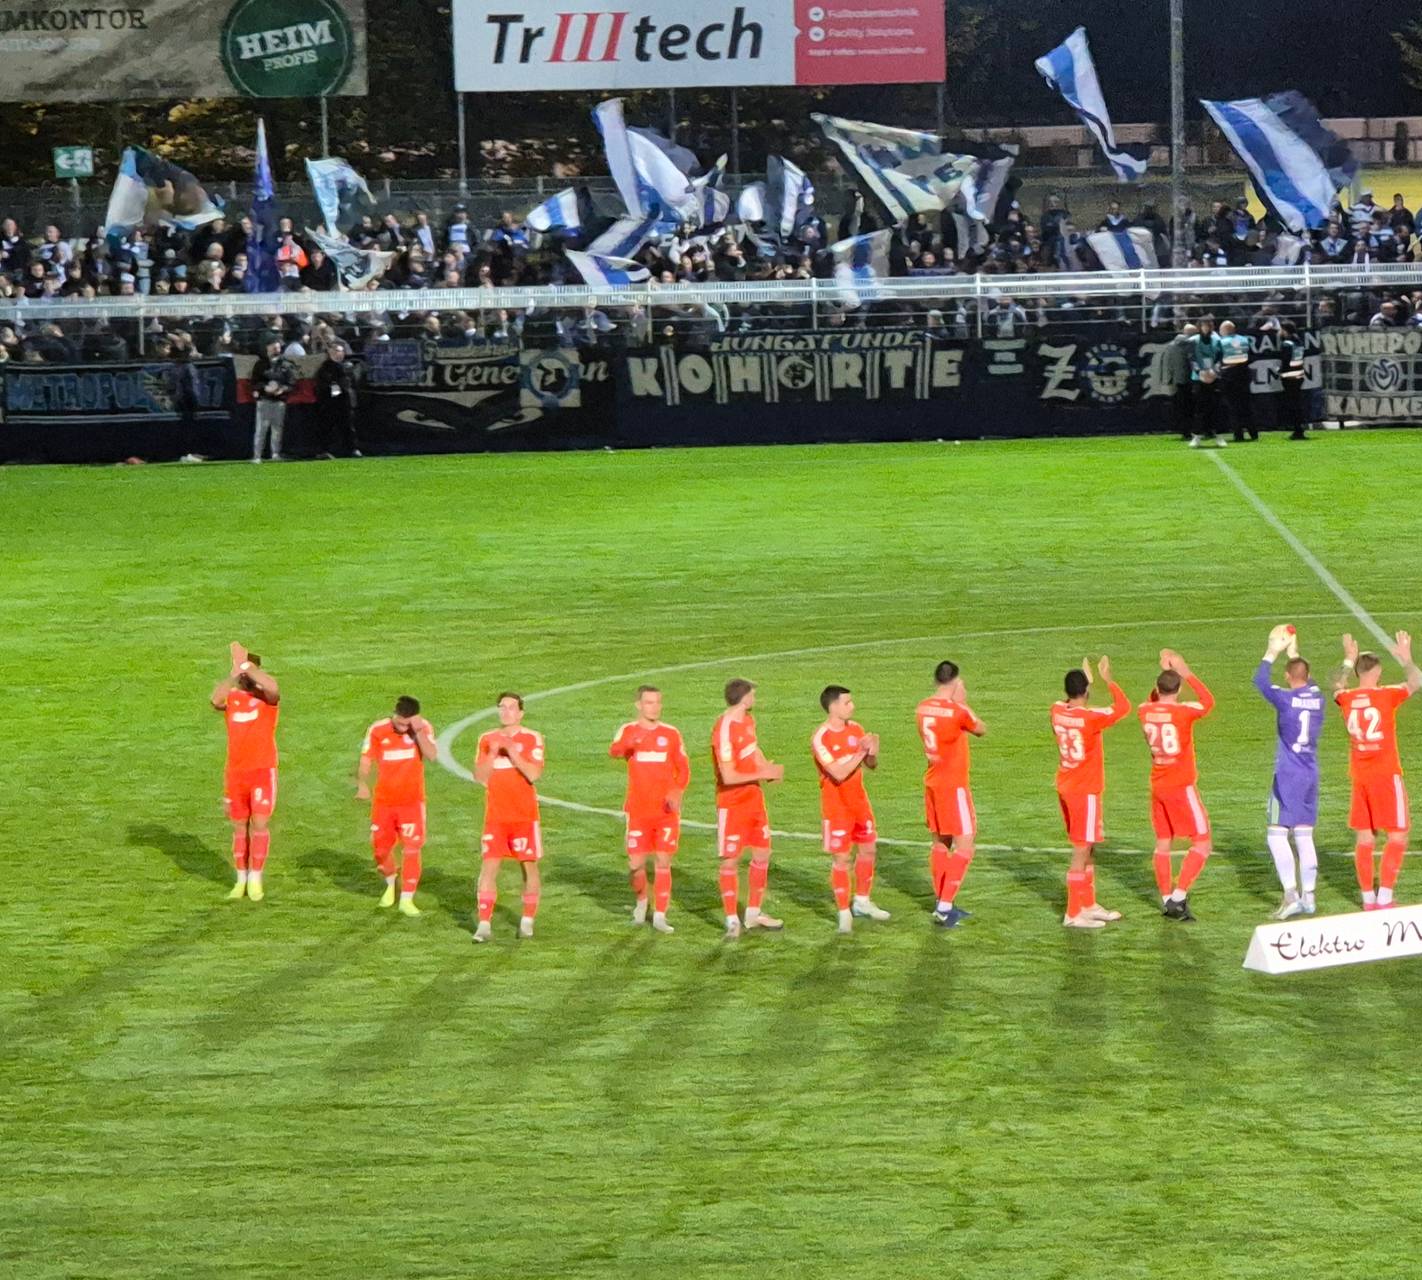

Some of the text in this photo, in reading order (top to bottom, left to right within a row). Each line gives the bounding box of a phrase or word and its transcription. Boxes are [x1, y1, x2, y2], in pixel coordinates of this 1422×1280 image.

[236, 20, 336, 59] HEIM
[922, 716, 937, 750] 5
[1144, 723, 1181, 755] 28
[1297, 709, 1311, 744] 1
[1347, 707, 1384, 742] 42
[663, 828, 671, 842] 7
[1270, 931, 1365, 960] Elektro
